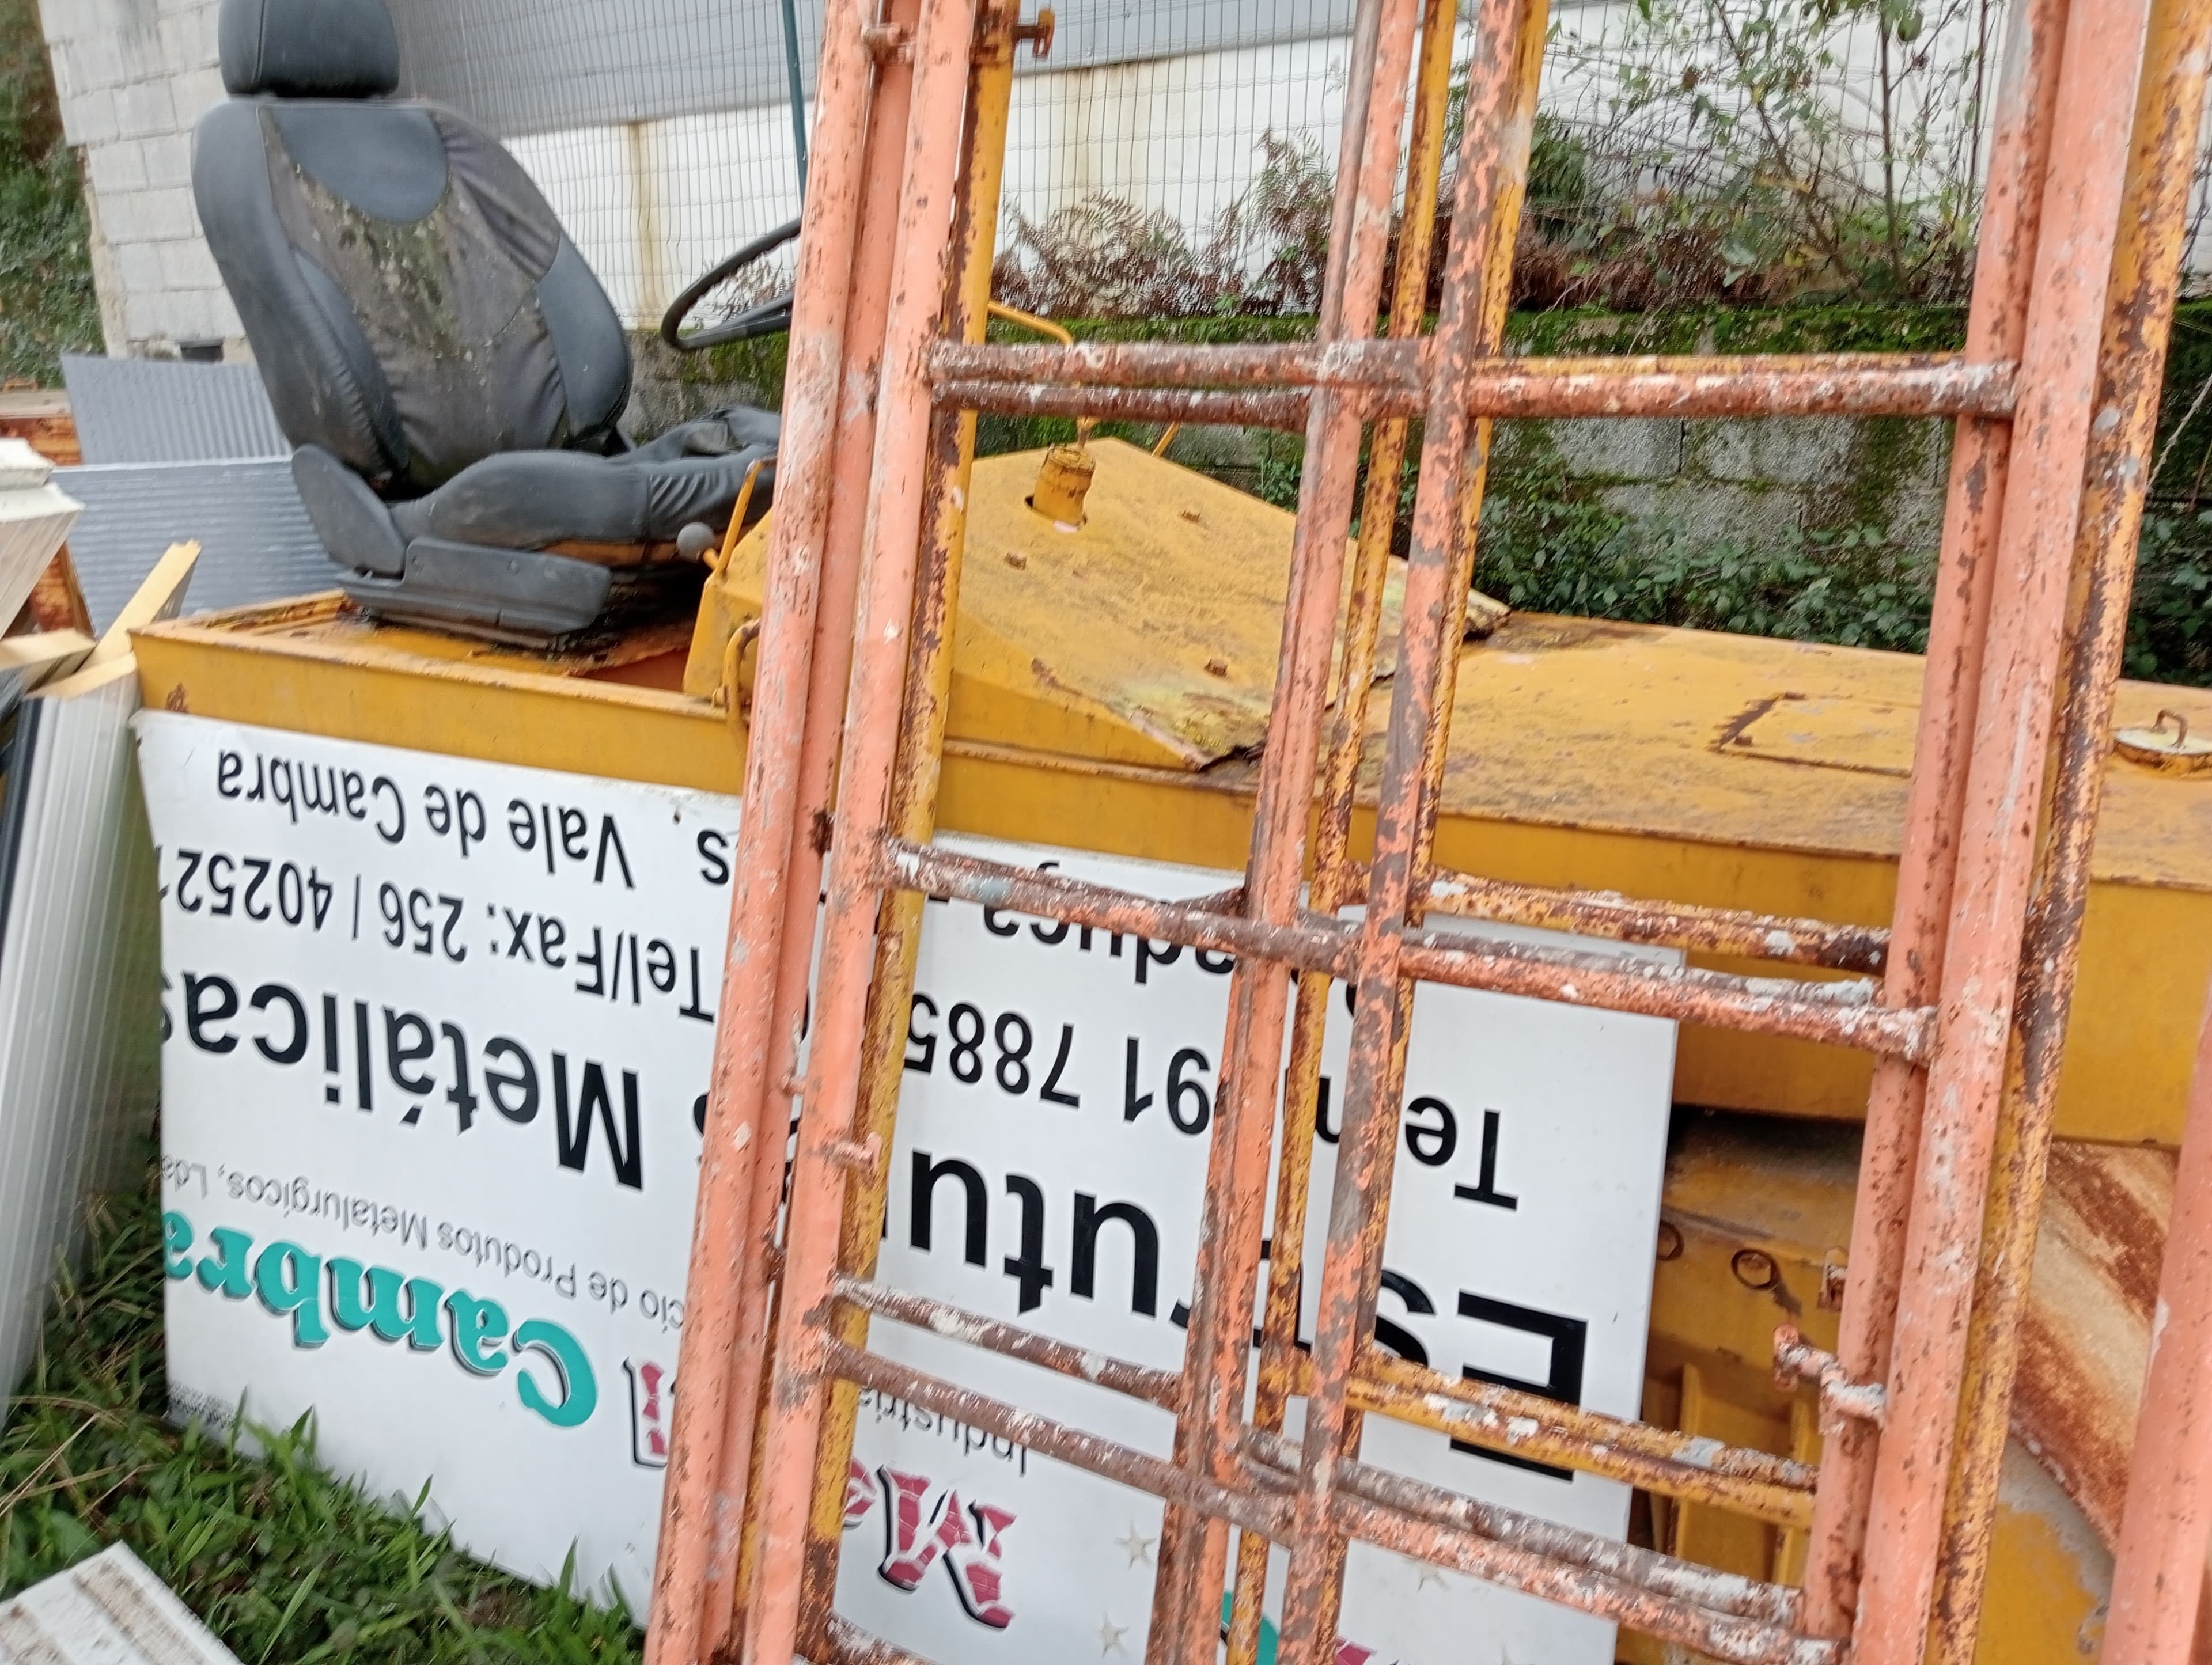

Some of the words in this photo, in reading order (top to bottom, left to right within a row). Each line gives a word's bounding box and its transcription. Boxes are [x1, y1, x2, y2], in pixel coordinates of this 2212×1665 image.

[217, 749, 405, 845] Cambra
[424, 785, 484, 858] de
[506, 798, 634, 890] Vale
[379, 881, 468, 964] 256
[487, 903, 714, 1027] Tel/Fax:
[161, 969, 644, 1196] Metálica
[1124, 1036, 1211, 1136] 91
[437, 1223, 576, 1300] Produtos
[588, 1271, 628, 1314] de
